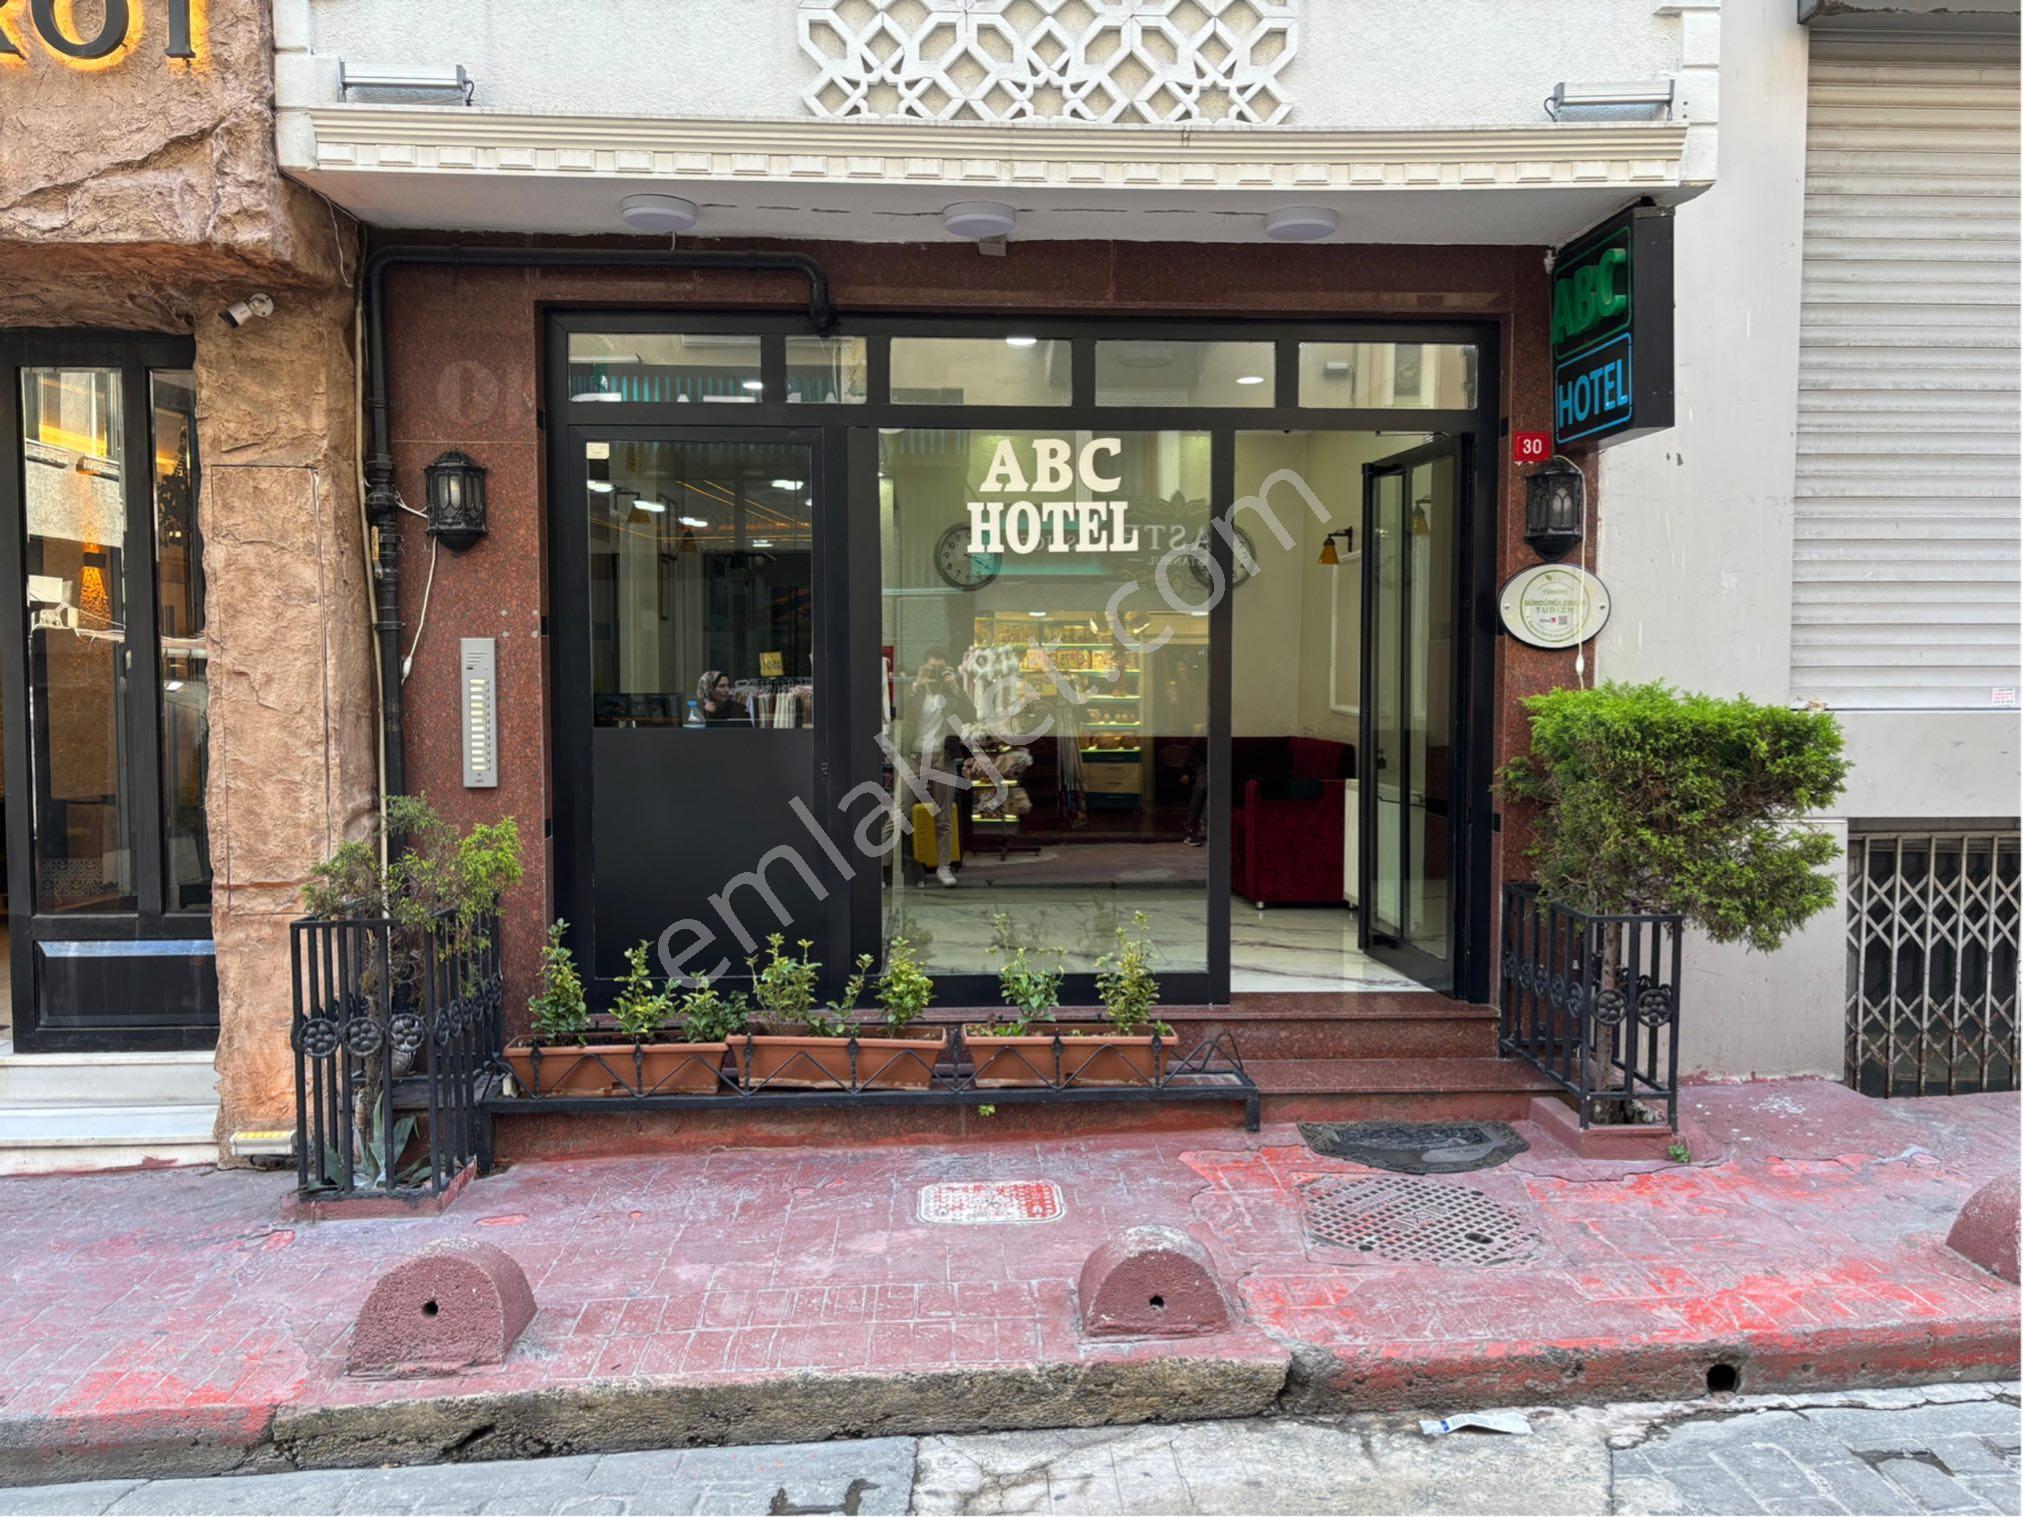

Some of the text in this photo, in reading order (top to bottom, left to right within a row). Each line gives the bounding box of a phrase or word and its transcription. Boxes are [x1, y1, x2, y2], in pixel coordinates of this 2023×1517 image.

[1553, 248, 1628, 345] ABC
[1558, 358, 1629, 429] HOTEL
[979, 437, 1122, 493] ABC
[1523, 438, 1543, 455] 30
[966, 500, 1139, 554] HOTEL
